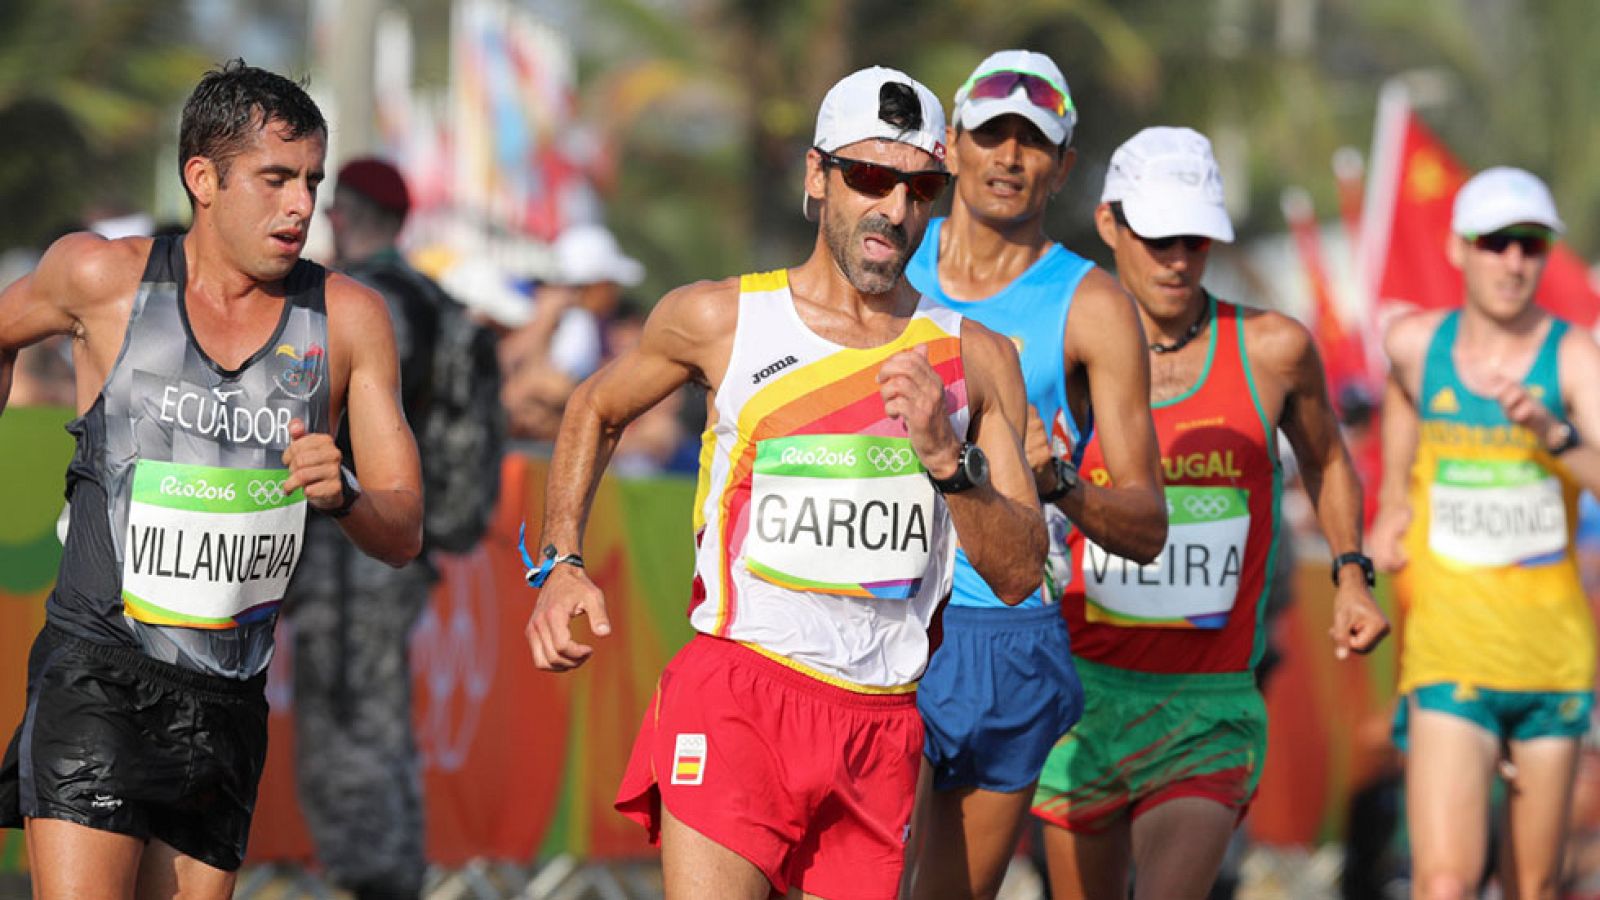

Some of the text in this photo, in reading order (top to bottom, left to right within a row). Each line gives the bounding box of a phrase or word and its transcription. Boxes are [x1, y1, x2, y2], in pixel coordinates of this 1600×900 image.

[160, 386, 291, 443] ECUADOR
[756, 493, 928, 552] GARCIA
[131, 524, 296, 583] VILLANUEVA
[1088, 544, 1240, 586] VIEIRA
